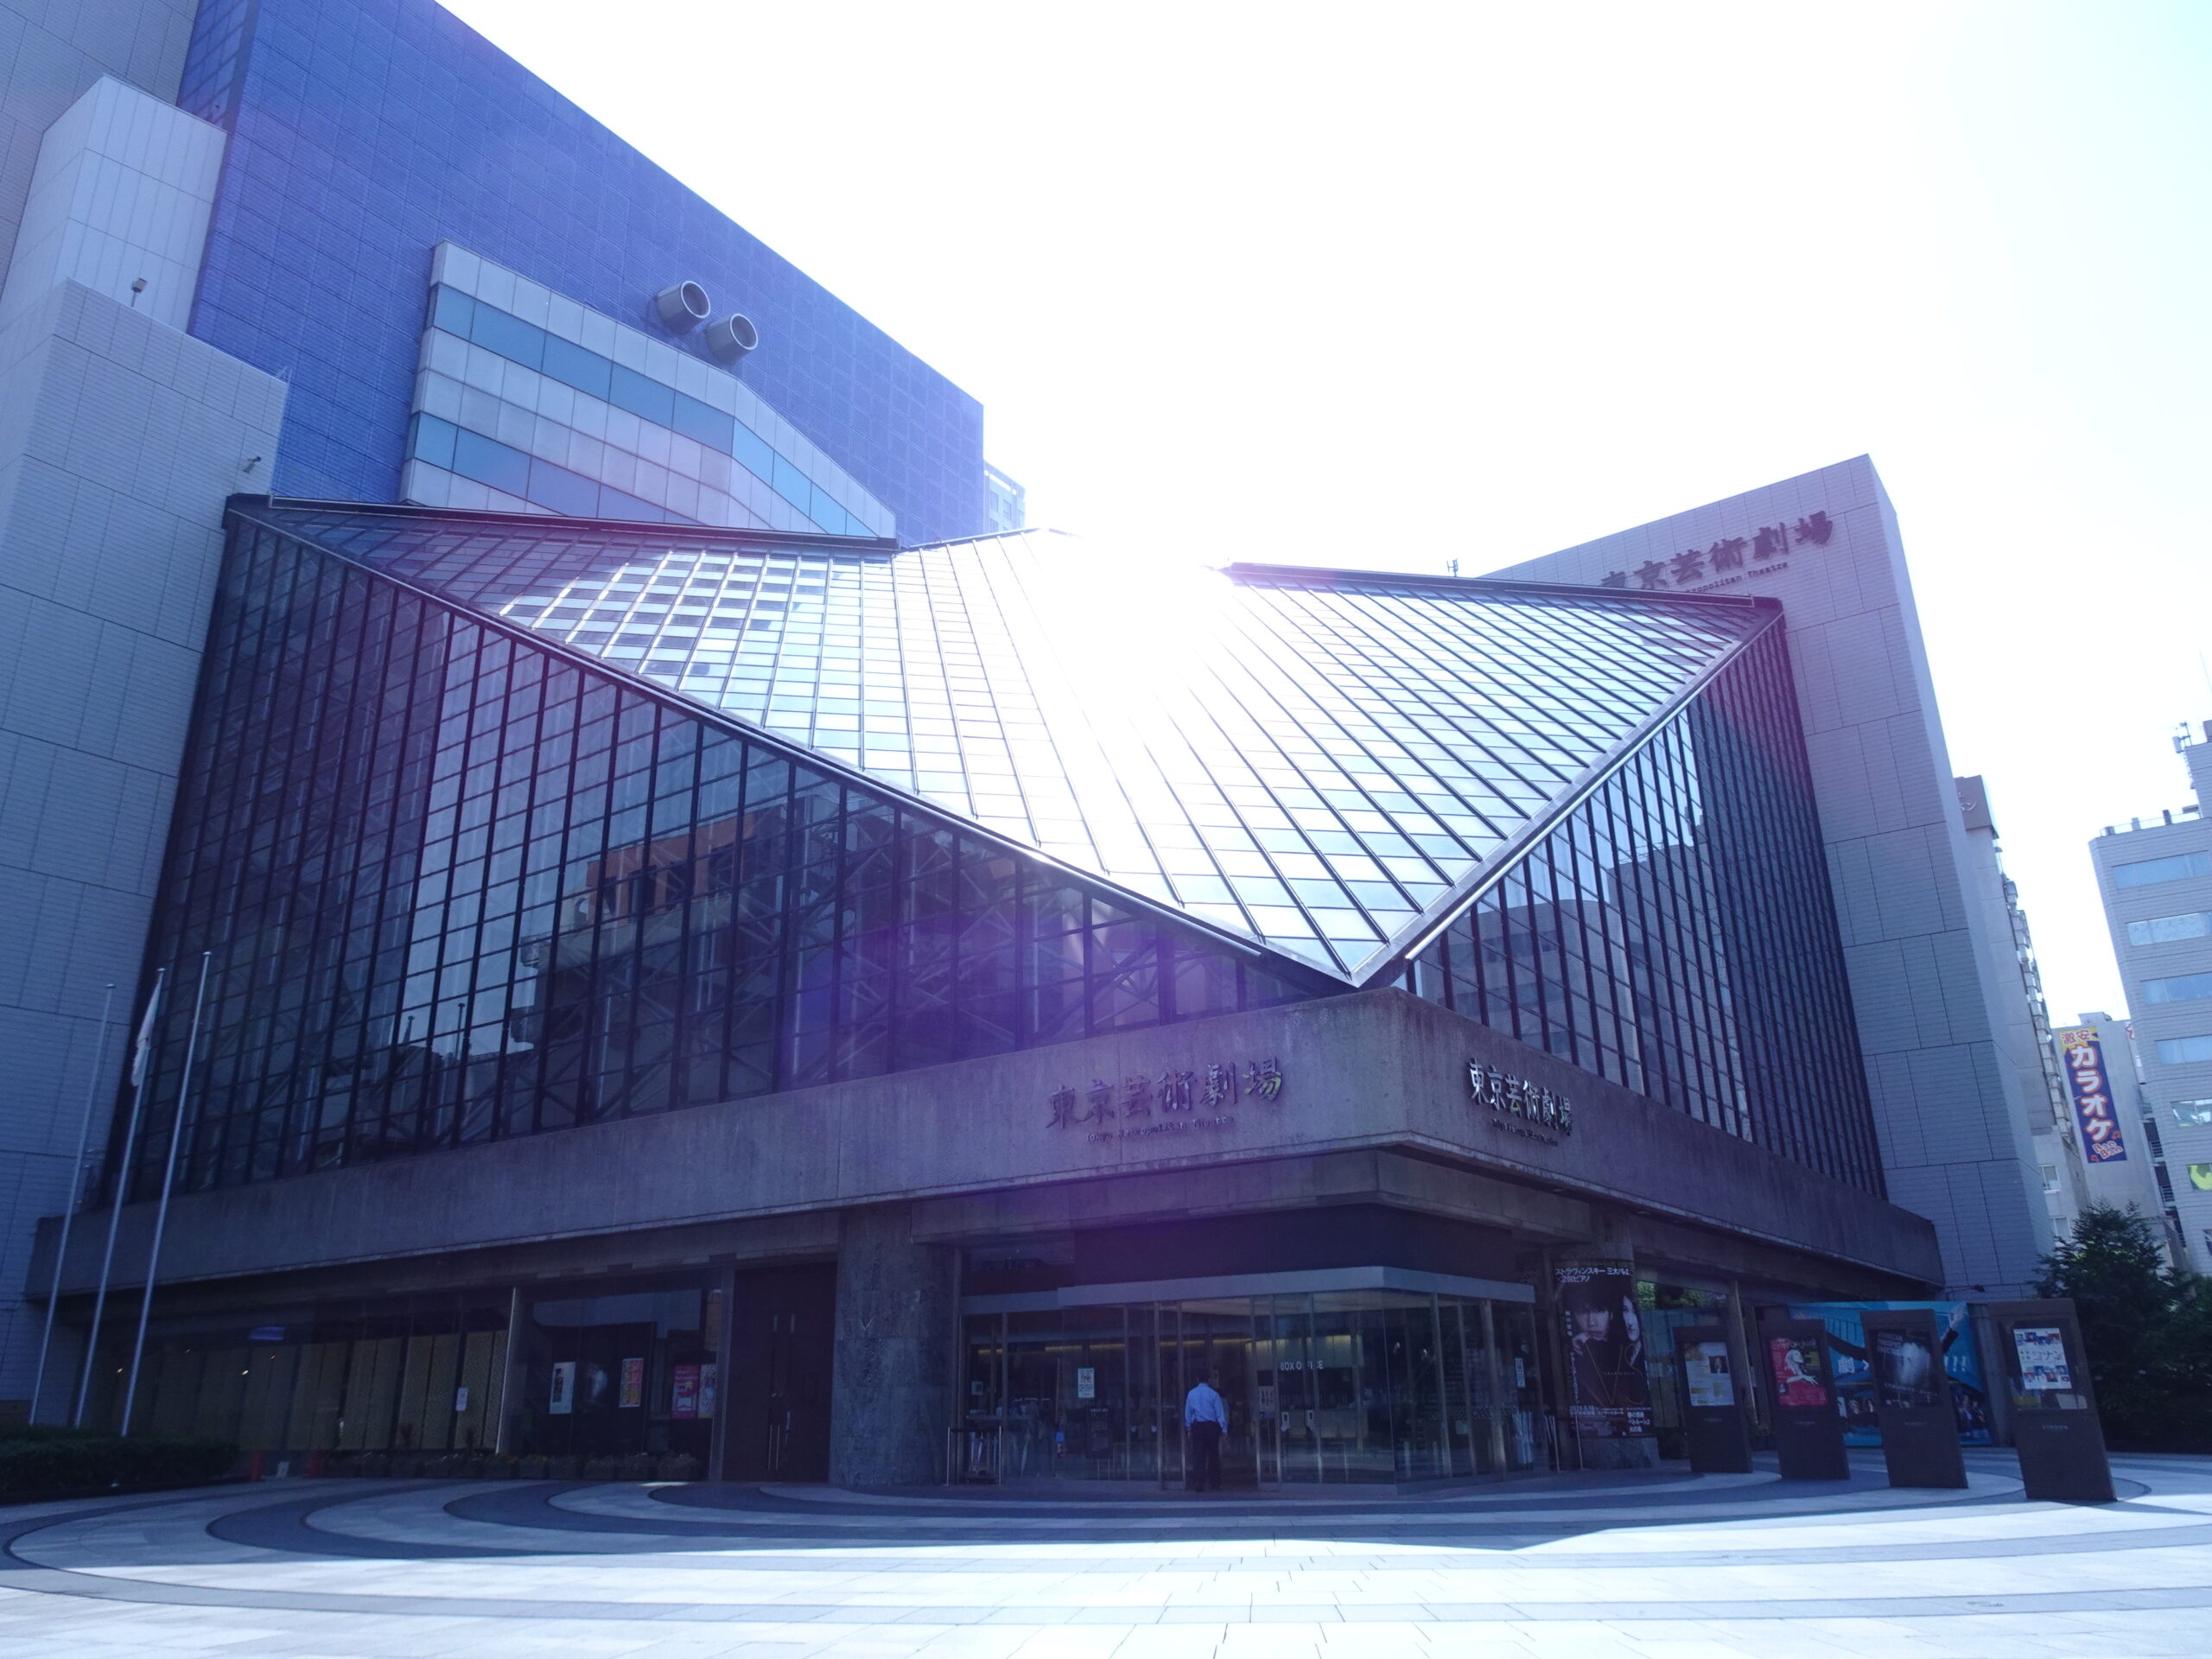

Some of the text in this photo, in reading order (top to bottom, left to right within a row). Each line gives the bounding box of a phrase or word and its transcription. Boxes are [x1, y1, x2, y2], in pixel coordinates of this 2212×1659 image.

[1747, 561, 1789, 579] Theatre
[1046, 1056, 1284, 1129] 東京芸術劇場
[1466, 1057, 1574, 1137] 東京芸術劇場
[2070, 1046, 2113, 1141] カラオケ
